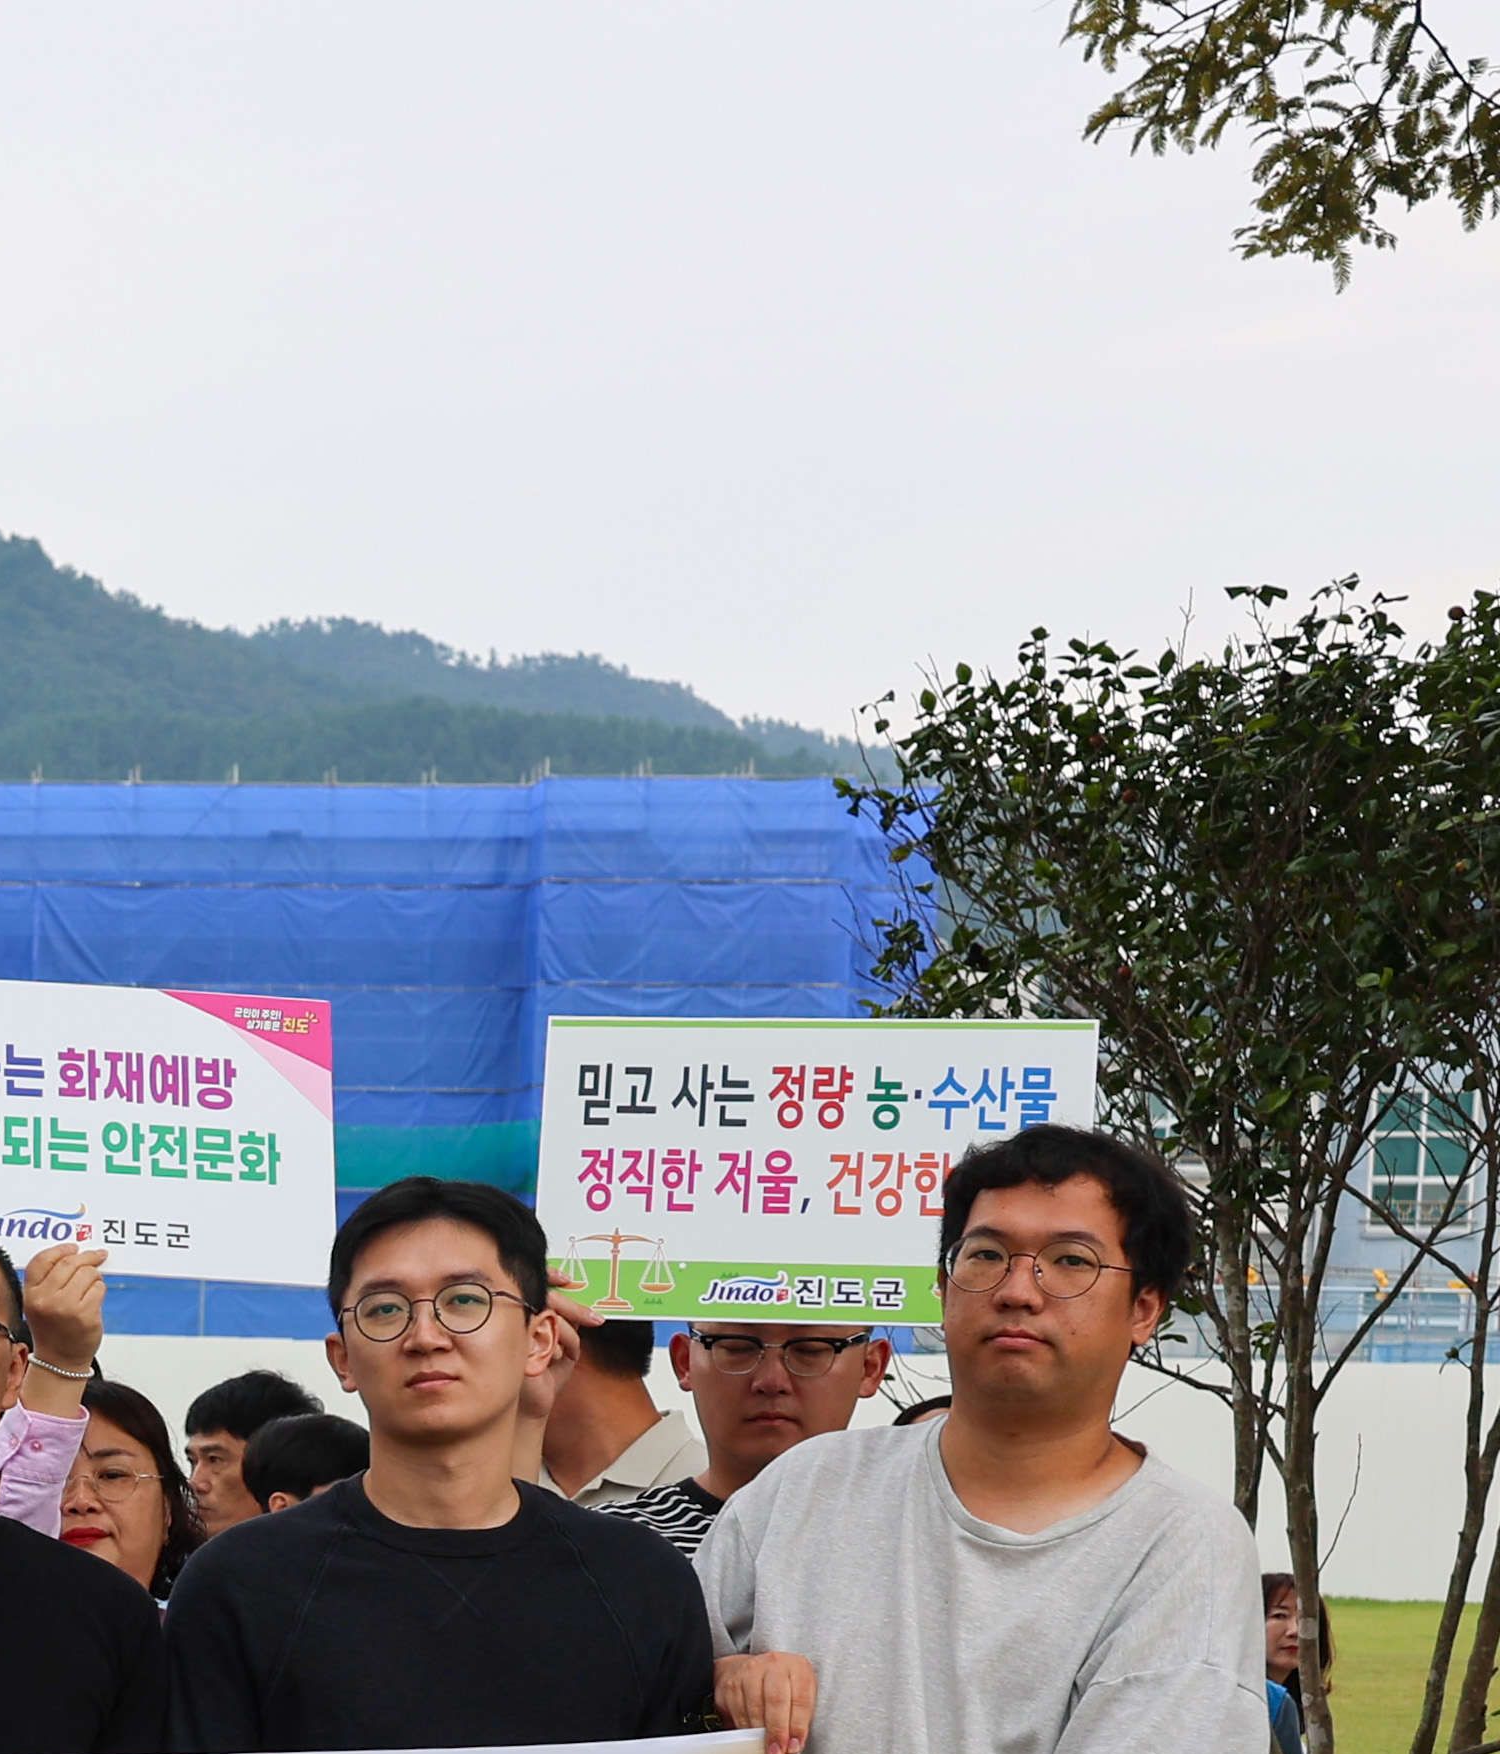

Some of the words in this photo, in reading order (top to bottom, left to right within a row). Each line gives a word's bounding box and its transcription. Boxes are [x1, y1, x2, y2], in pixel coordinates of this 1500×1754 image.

[282, 1017, 309, 1034] 진도
[58, 1048, 236, 1110] 화재예방
[578, 1063, 657, 1125] 믿고
[671, 1064, 755, 1127] 사는
[768, 1065, 854, 1129] 정량
[102, 1122, 281, 1185] 안전문화
[578, 1148, 702, 1212] 정직한
[714, 1150, 811, 1214] 저울,
[103, 1219, 191, 1249] 진도군
[701, 1279, 776, 1304] Jindo
[795, 1276, 906, 1309] 진도군
